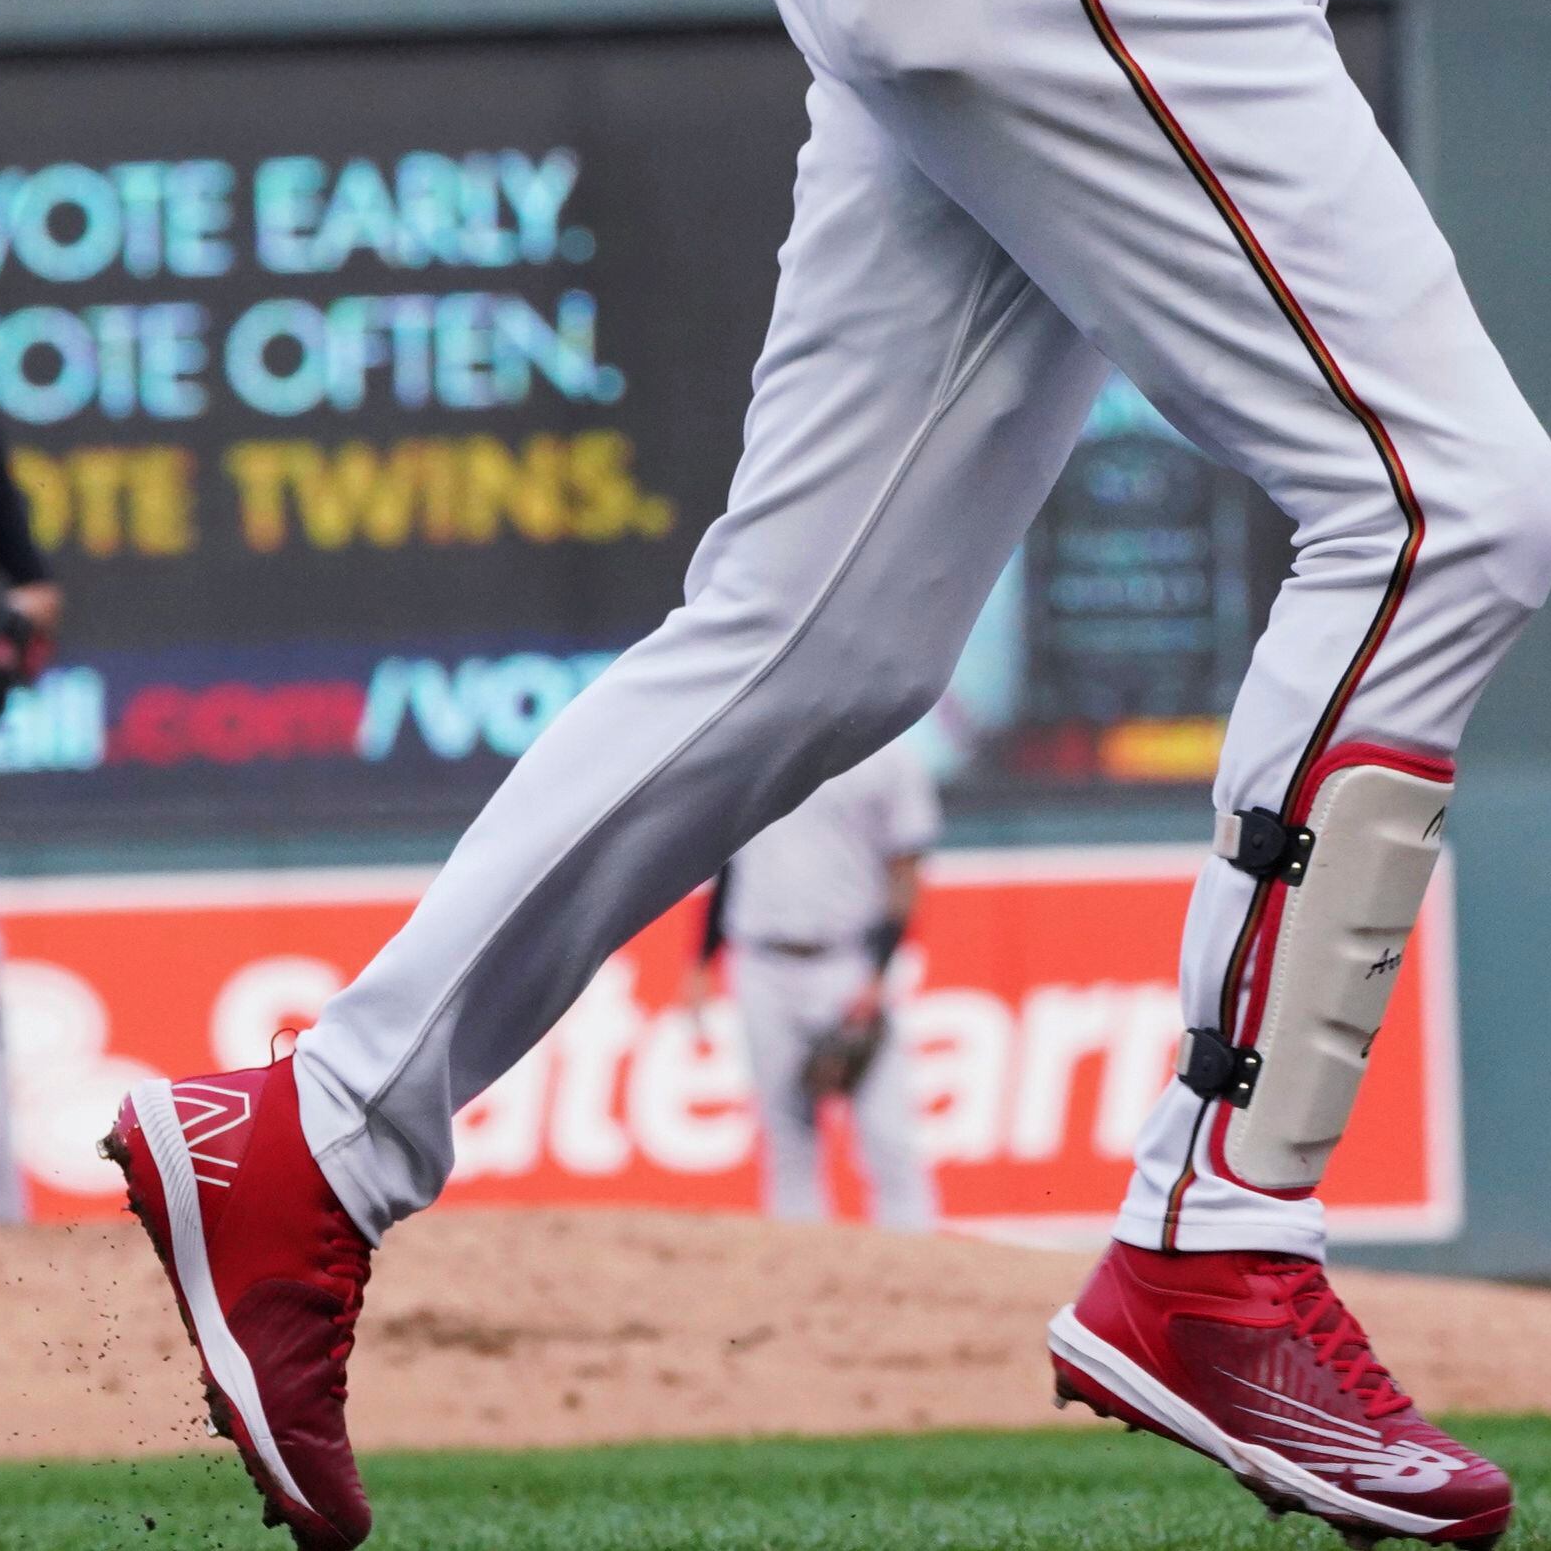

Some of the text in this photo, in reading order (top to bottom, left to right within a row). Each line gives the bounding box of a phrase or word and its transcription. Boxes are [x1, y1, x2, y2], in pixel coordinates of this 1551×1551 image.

[255, 146, 596, 273] EARLY.
[225, 288, 626, 417] OFTEN.
[227, 430, 673, 553] TWINS.
